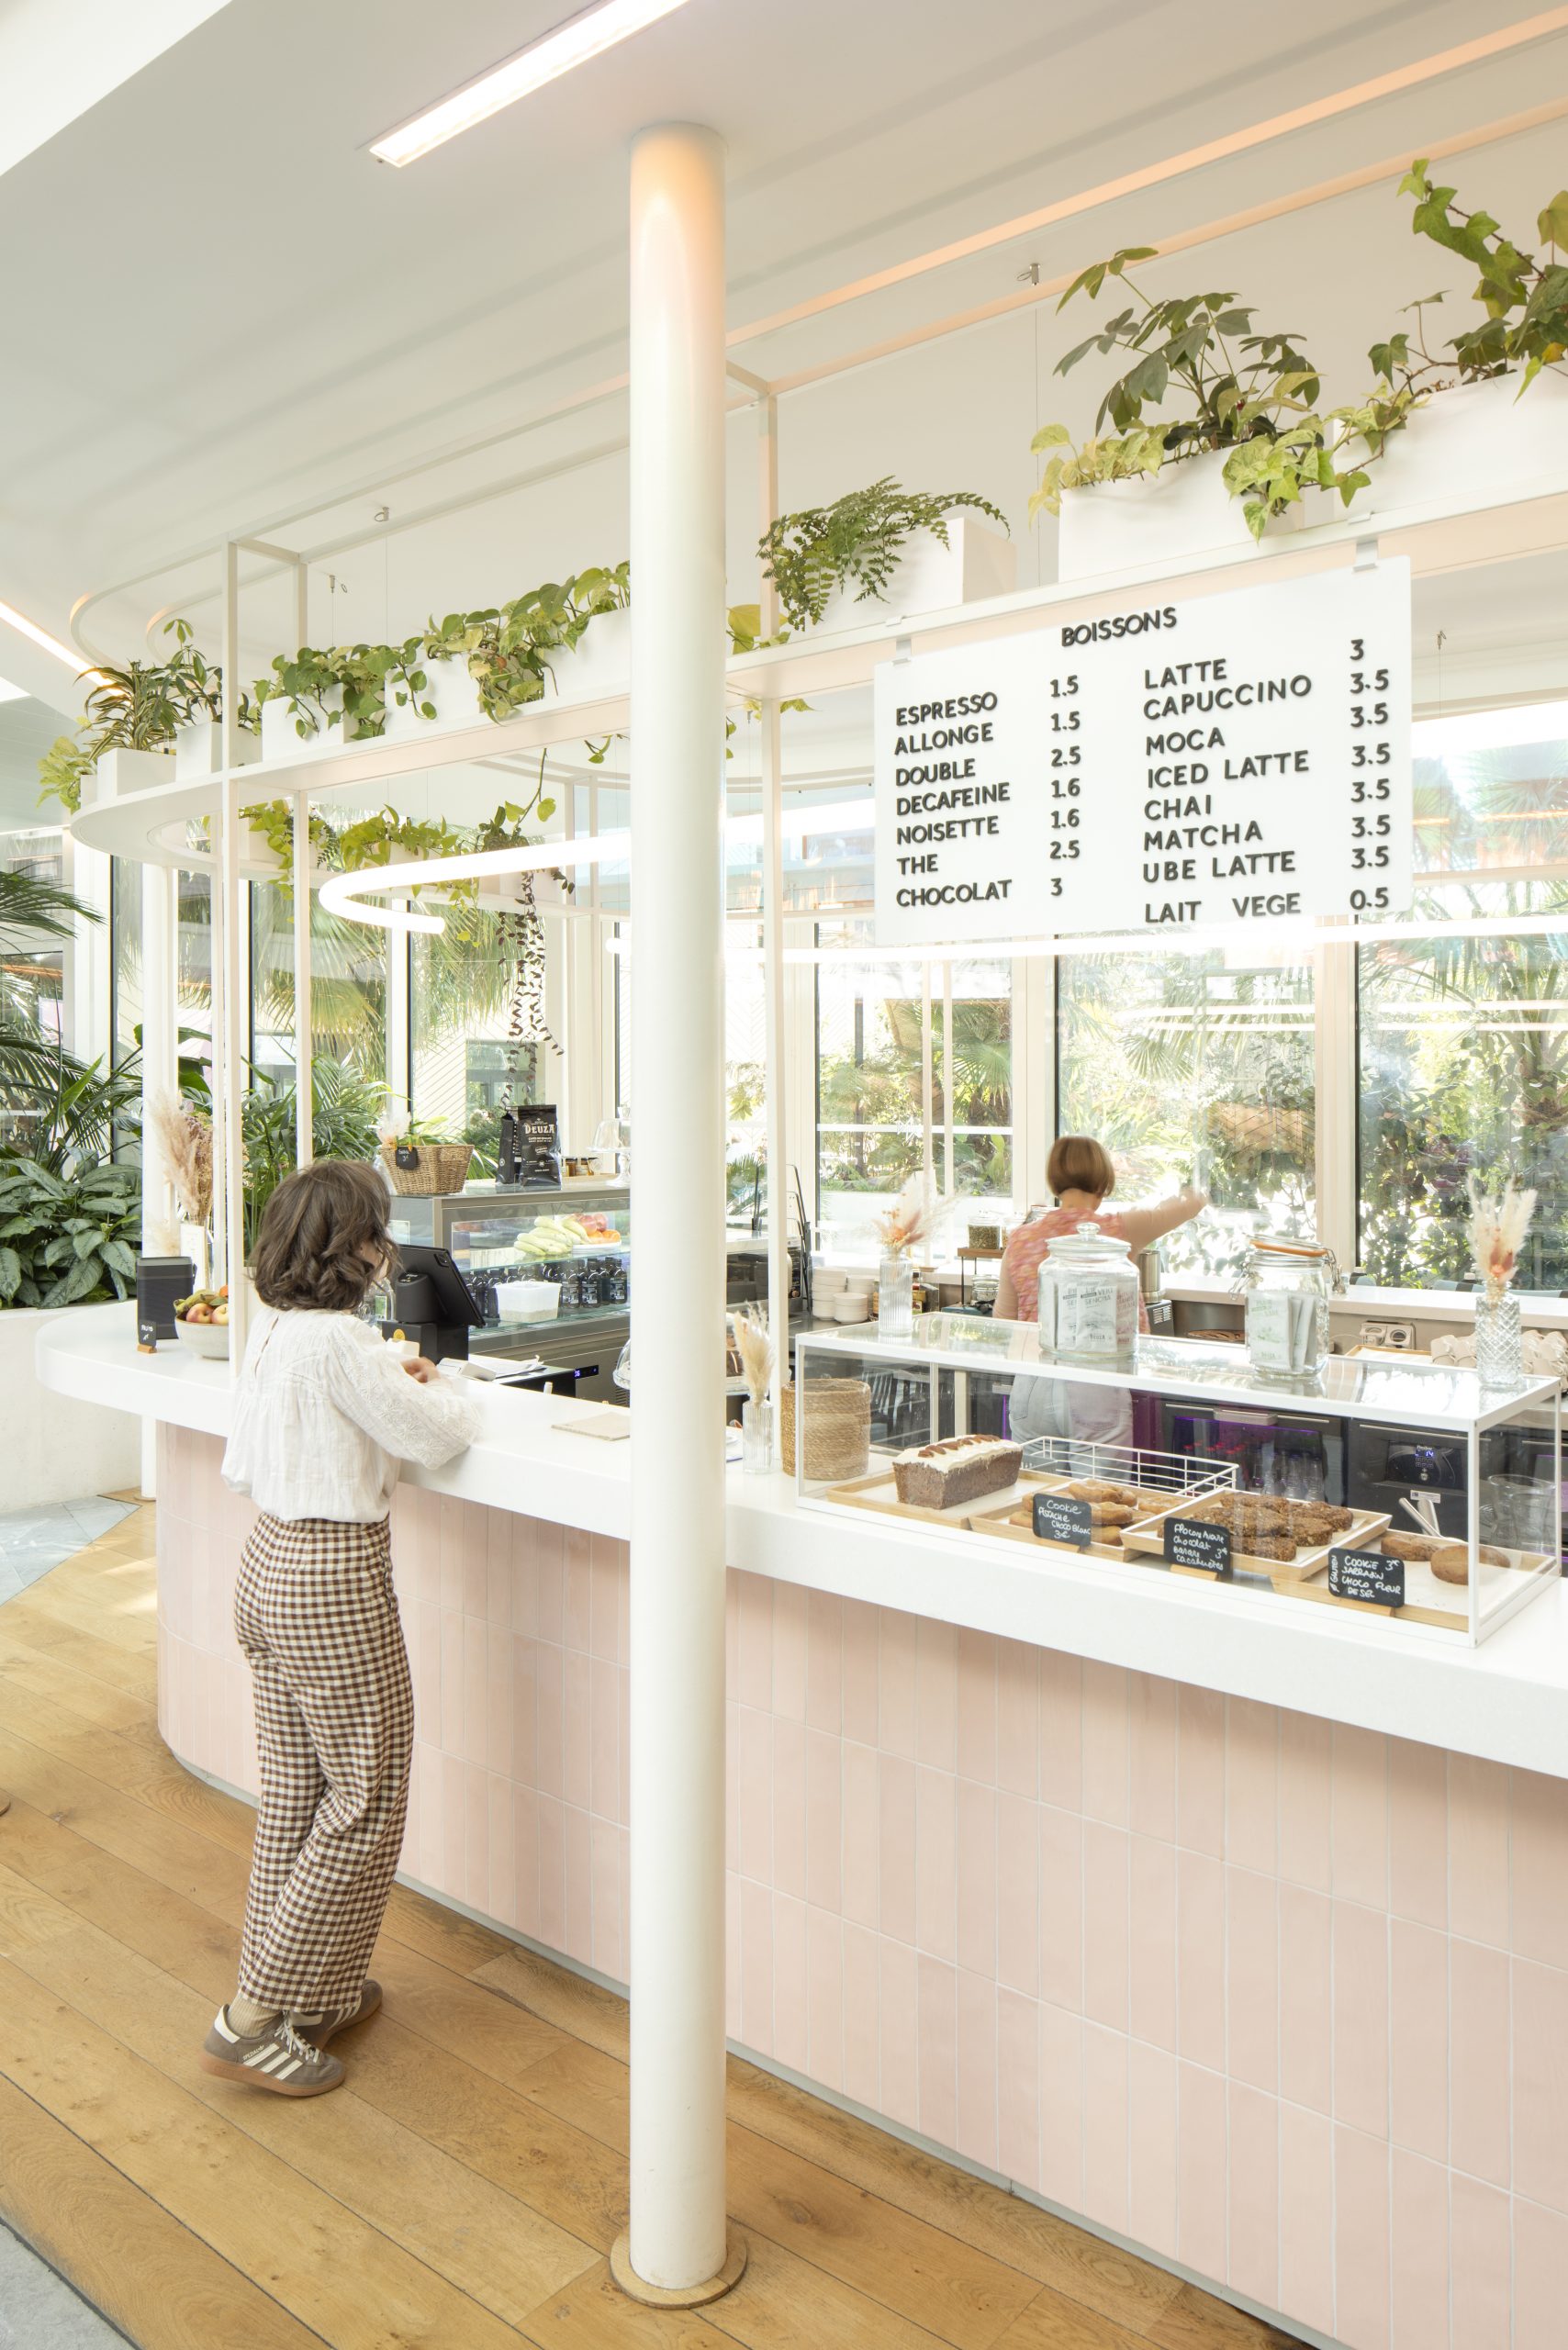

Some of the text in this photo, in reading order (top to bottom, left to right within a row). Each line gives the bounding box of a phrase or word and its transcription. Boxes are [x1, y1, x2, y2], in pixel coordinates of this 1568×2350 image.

[1062, 607, 1176, 646] BOISSONS
[1350, 639, 1363, 660] 3
[1050, 676, 1080, 698] 1.5
[1144, 659, 1226, 690] LATTE
[1350, 669, 1388, 694] 3.5
[896, 692, 997, 726] ESPRESSO
[1144, 675, 1311, 720] CAPUCCINO
[1051, 711, 1080, 731] 1.5
[1351, 702, 1388, 727] 3.5
[895, 722, 993, 755] ALLONGE
[1147, 728, 1225, 755] MOCA
[1051, 746, 1081, 767] 2.5
[1352, 743, 1390, 767] 3.5
[896, 758, 975, 786] DOUBLE
[1148, 750, 1308, 789] ICED LATTE
[896, 782, 1010, 815] DECAFEINE
[1052, 778, 1080, 799] 1.6
[1351, 778, 1389, 802] 3.5
[1051, 809, 1080, 828] 1.6
[1145, 795, 1211, 821] CHAI
[897, 816, 999, 845] NOISETTE
[1145, 821, 1262, 851] MATCHA
[1352, 815, 1390, 837] 3.5
[1050, 840, 1080, 859] 2.5
[1351, 845, 1389, 868] 3.5
[897, 854, 938, 875] THE
[1144, 851, 1295, 882] UBE LATTE
[897, 879, 1012, 907] CHOCOLAT
[1051, 878, 1062, 896] 3
[1146, 893, 1300, 923] LAIT VEGE
[1350, 888, 1388, 914] 0.5
[525, 1124, 554, 1135] DEUZA
[1047, 1500, 1081, 1515] Cookie
[1054, 1529, 1070, 1539] 3€
